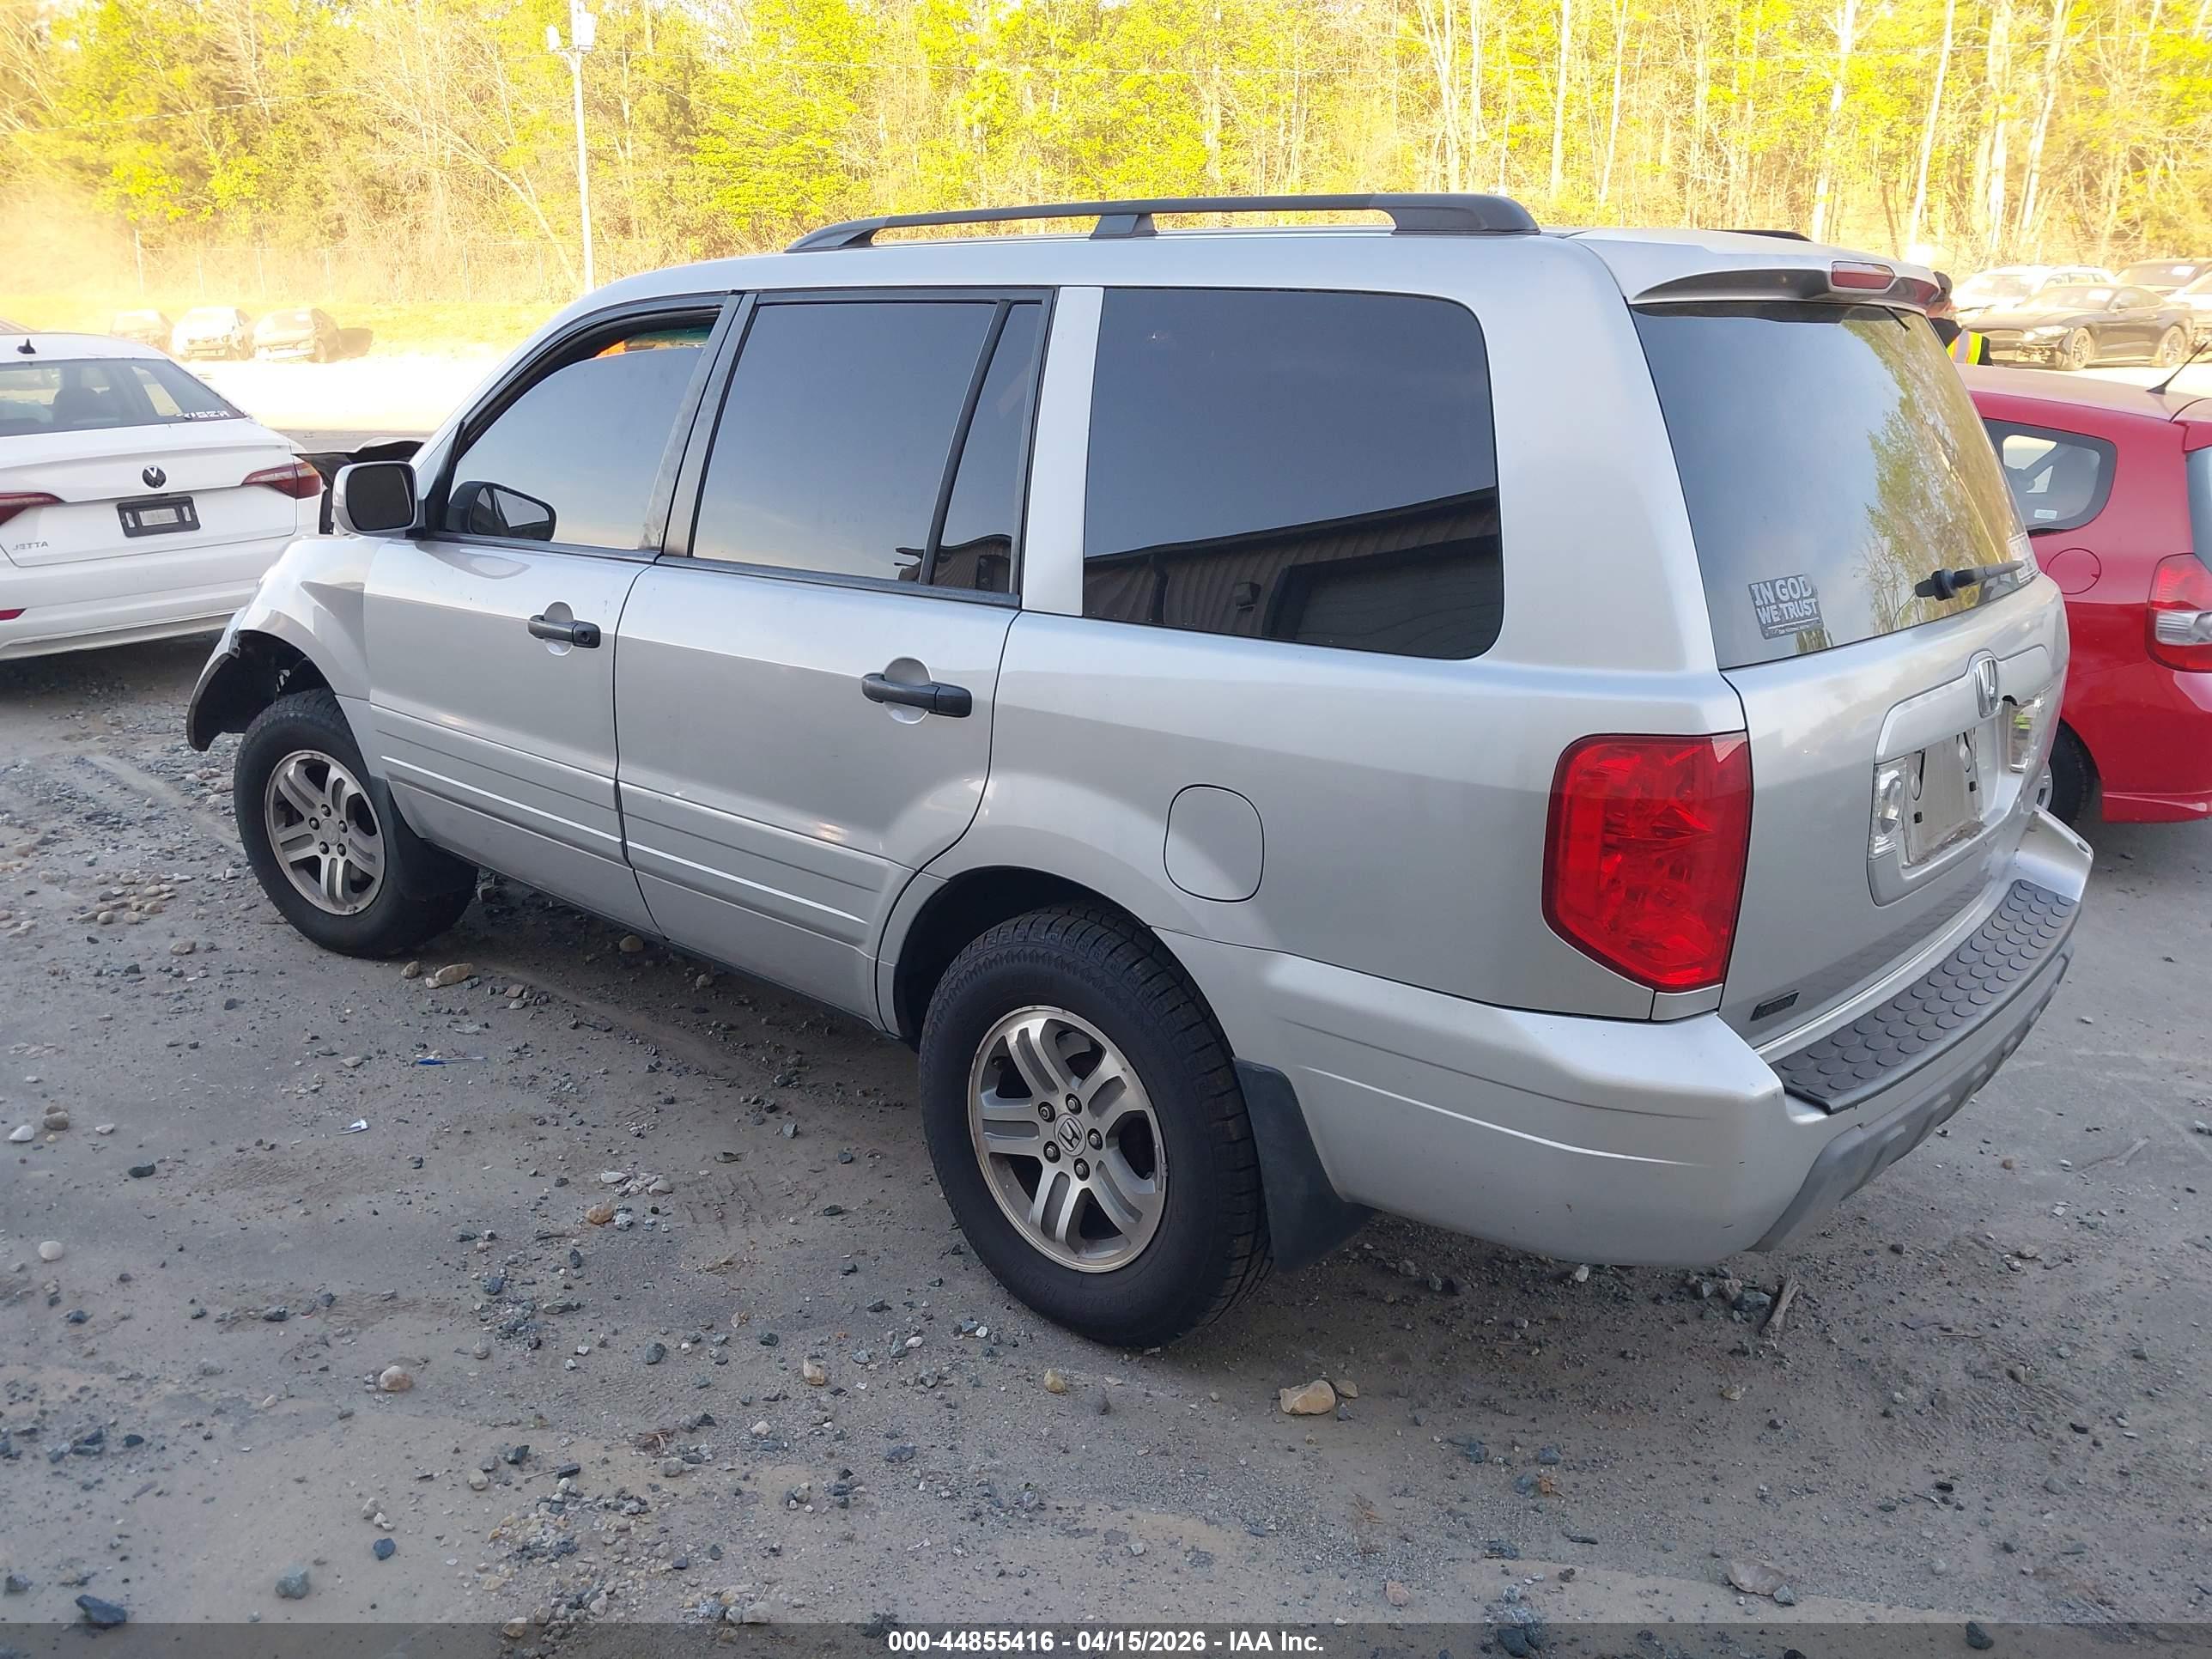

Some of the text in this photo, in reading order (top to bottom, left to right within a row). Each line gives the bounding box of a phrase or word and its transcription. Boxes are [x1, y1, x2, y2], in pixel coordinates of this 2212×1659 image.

[13, 541, 49, 550] JETTA
[1751, 576, 1813, 606] IN GOD
[1756, 598, 1818, 625] WE TRUST
